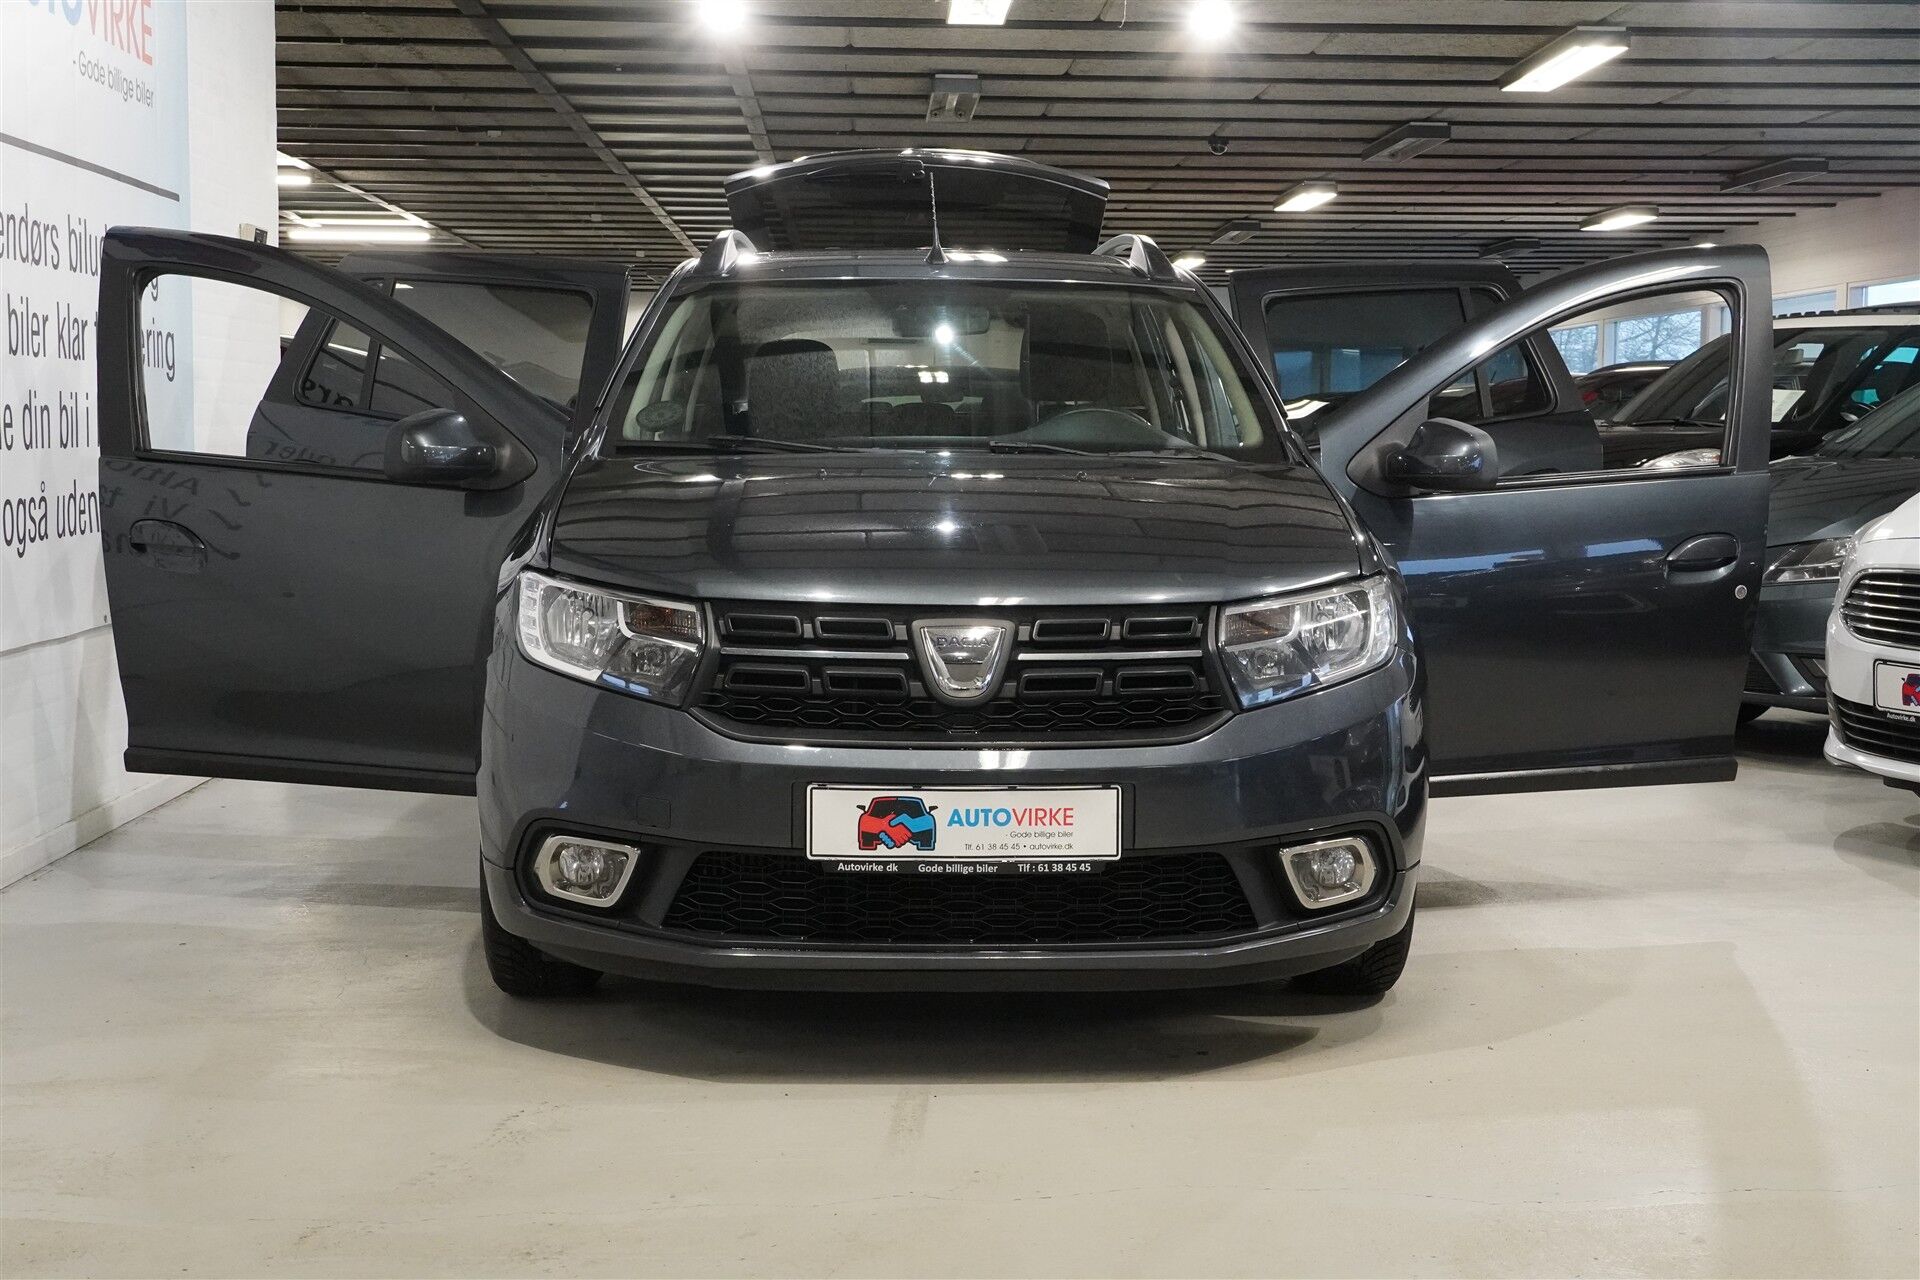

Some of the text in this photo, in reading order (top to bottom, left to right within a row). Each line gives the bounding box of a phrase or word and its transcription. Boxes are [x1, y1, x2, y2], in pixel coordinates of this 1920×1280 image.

[78, 51, 106, 85] Gode
[107, 64, 134, 102] billige
[135, 78, 154, 108] biler
[7, 293, 88, 361] biler klar
[22, 389, 51, 450] din
[59, 390, 79, 449] bil
[3, 479, 100, 558] også uden
[947, 807, 1074, 828] AUTOVIRKE
[1009, 830, 1032, 839] Gode
[1034, 830, 1056, 840] billige
[1057, 830, 1074, 839] biler
[975, 843, 985, 851] 61
[987, 843, 997, 851] 38
[999, 843, 1009, 851] 45
[1010, 843, 1021, 851] 45
[1029, 842, 1074, 851] autovirke.dk
[837, 862, 899, 872] Autovirke dk
[918, 863, 998, 875] Gode billige biler
[1017, 863, 1032, 872] Tlf
[1037, 863, 1050, 872] 61
[1051, 863, 1063, 872] 38
[1065, 863, 1077, 872] 45
[1079, 863, 1092, 872] 45
